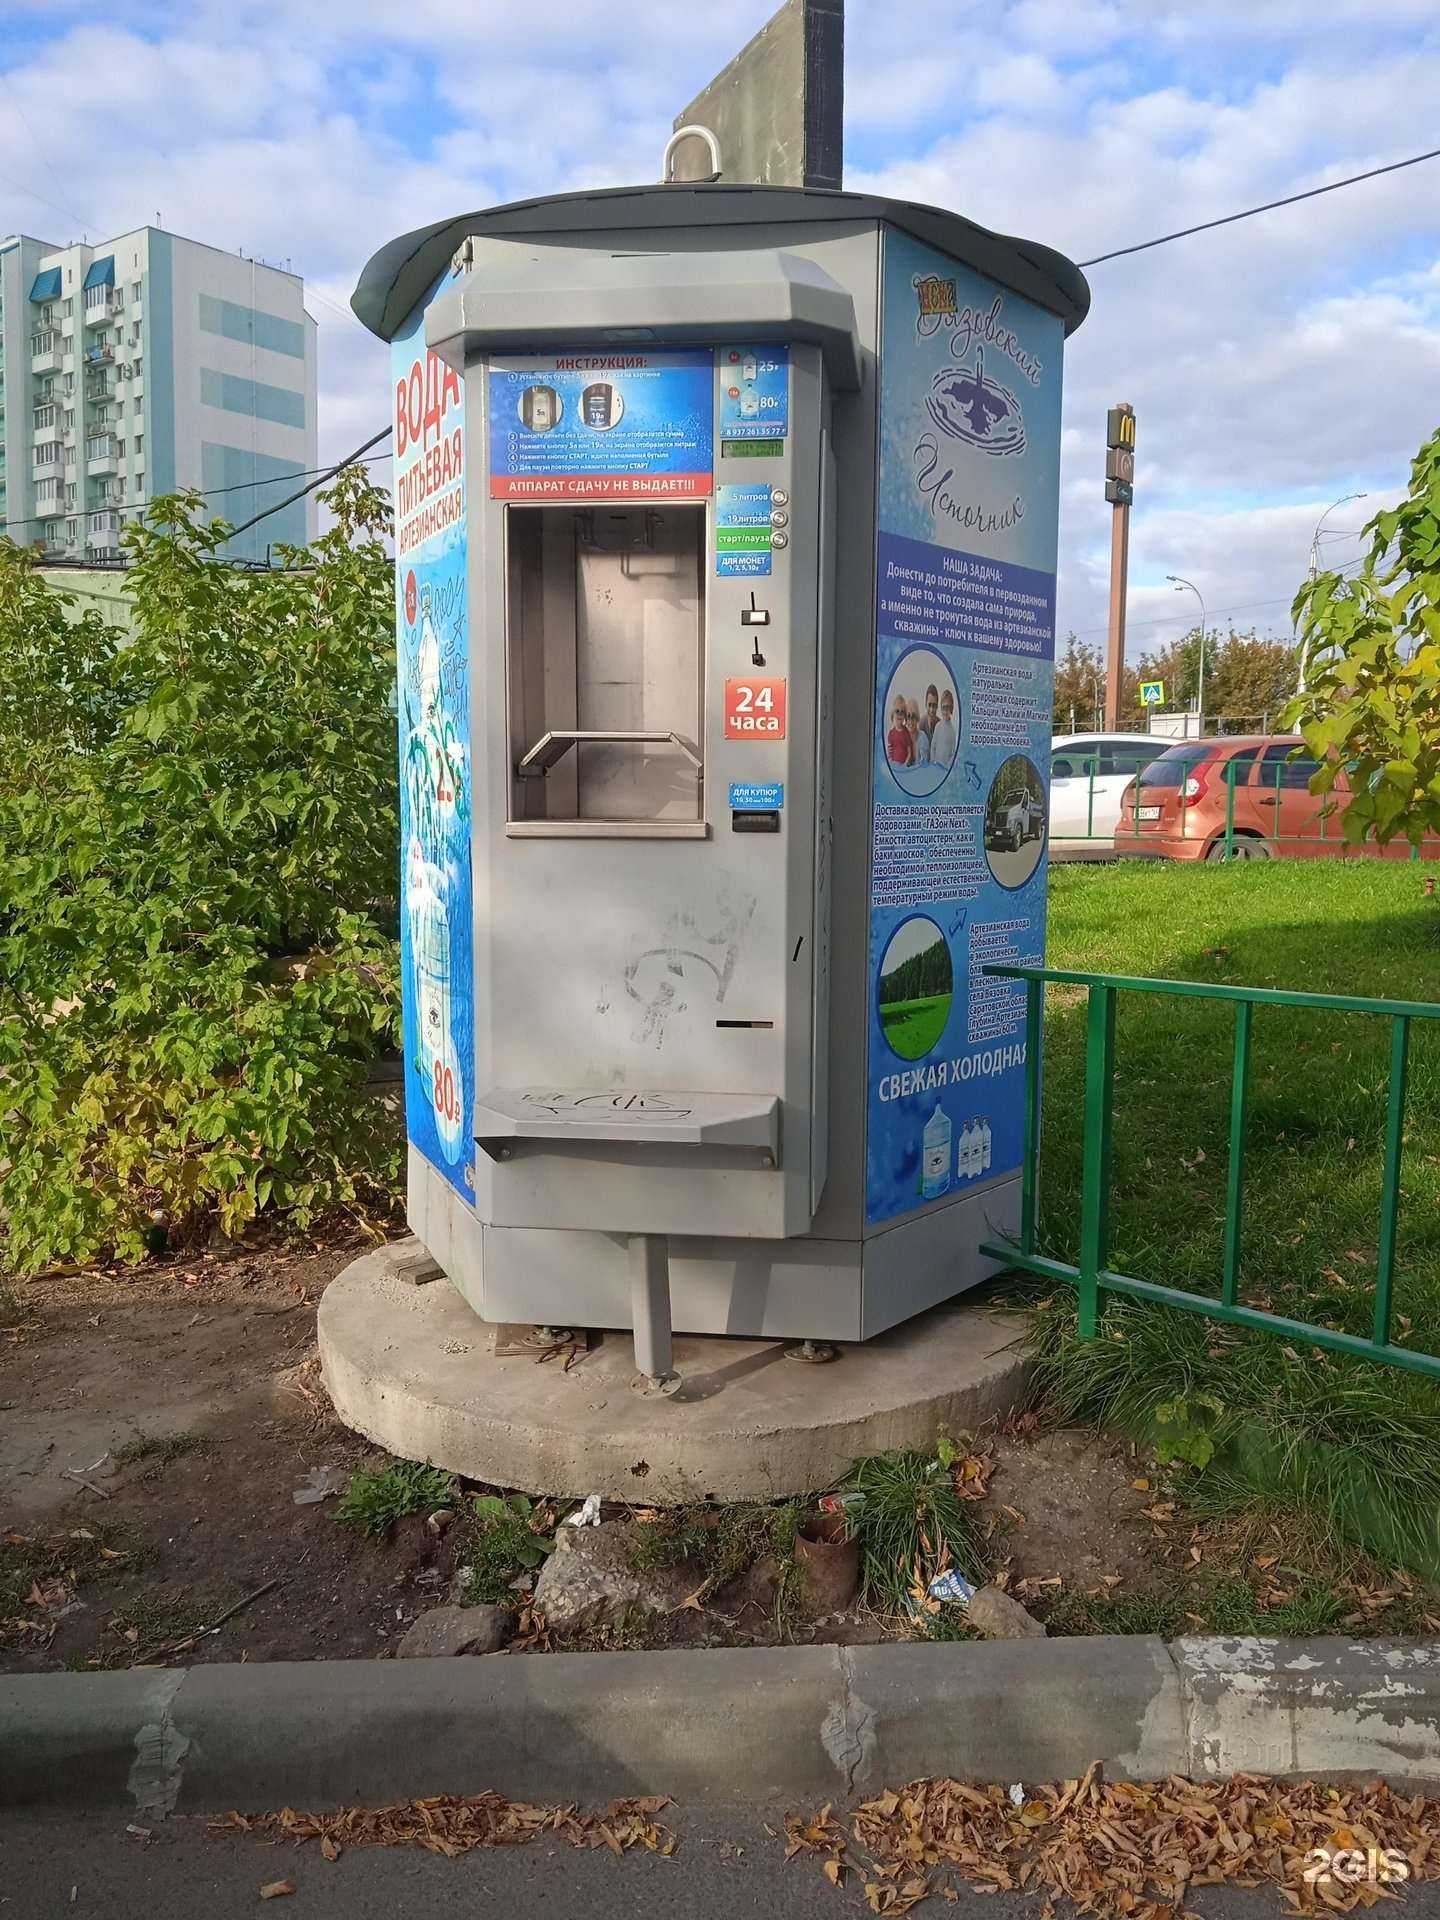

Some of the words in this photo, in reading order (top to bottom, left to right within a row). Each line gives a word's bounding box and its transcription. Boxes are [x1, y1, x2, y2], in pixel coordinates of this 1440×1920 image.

[556, 357, 648, 370] ИНСТРУКЦИЯ:
[396, 348, 460, 458] ВОДА
[398, 427, 462, 519] ПИТЬЕВАЯ
[508, 481, 565, 492] АППАРАТ
[568, 481, 610, 492] СДАЧУ
[613, 480, 629, 492] НЕ
[632, 479, 696, 492] ВЫДАЕТ!!!
[400, 487, 462, 557] АРТЕЗИАНСКАЯ
[738, 515, 768, 524] литров
[718, 534, 770, 544] старт/пауза
[722, 558, 738, 566] ДЛЯ
[943, 556, 969, 576] НАША
[970, 562, 1002, 582] ЗАДАЧА:
[886, 562, 924, 581] Донести
[926, 572, 936, 586] до
[938, 575, 988, 594] потребителя
[990, 587, 994, 597] в
[996, 588, 1048, 608] первозданном
[900, 585, 922, 598] виде
[924, 588, 936, 602] то,
[936, 592, 951, 605] что
[952, 595, 984, 611] создала
[985, 602, 1003, 615] сама
[1004, 606, 1037, 622] природа,
[881, 600, 887, 610] а
[888, 601, 922, 617] именно
[923, 608, 934, 619] не
[936, 610, 973, 626] тронутая
[974, 616, 992, 630] вода
[994, 620, 1002, 630] из
[1004, 622, 1052, 639] артезианской
[894, 620, 939, 636] скважины
[944, 628, 966, 641] ключ
[968, 632, 973, 642] к
[974, 633, 1004, 648] вашему
[1004, 637, 1042, 652] здоровью!
[972, 662, 1017, 676] Артезианская
[1018, 670, 1033, 680] вода
[736, 687, 774, 712] 24
[972, 692, 1008, 704] природная
[1008, 696, 1038, 708] содержит
[730, 716, 779, 730] часа
[971, 719, 1015, 732] необходимые
[970, 735, 1000, 746] здоровья
[733, 788, 749, 796] ДЛЯ
[750, 788, 778, 796] КУПЮР
[875, 804, 909, 818] Доставка
[910, 805, 930, 816] воды
[930, 805, 984, 818] осуществляется
[874, 820, 921, 832] водовозами
[874, 833, 906, 846] Емкости
[956, 834, 968, 843] как
[874, 850, 894, 862] баки
[929, 846, 976, 858] обеспеченны
[874, 862, 925, 876] необходимой
[873, 875, 942, 892] поддерживающей
[942, 871, 990, 885] естественный
[872, 892, 932, 907] температурный
[933, 890, 958, 902] режим
[970, 922, 1014, 937] Артезианская
[1014, 920, 1030, 930] вода
[970, 934, 1008, 950] добывается
[975, 946, 1018, 960] экологически
[970, 992, 984, 1002] села
[968, 1027, 1001, 1042] скважины
[878, 1062, 947, 1102] СВЕЖАЯ
